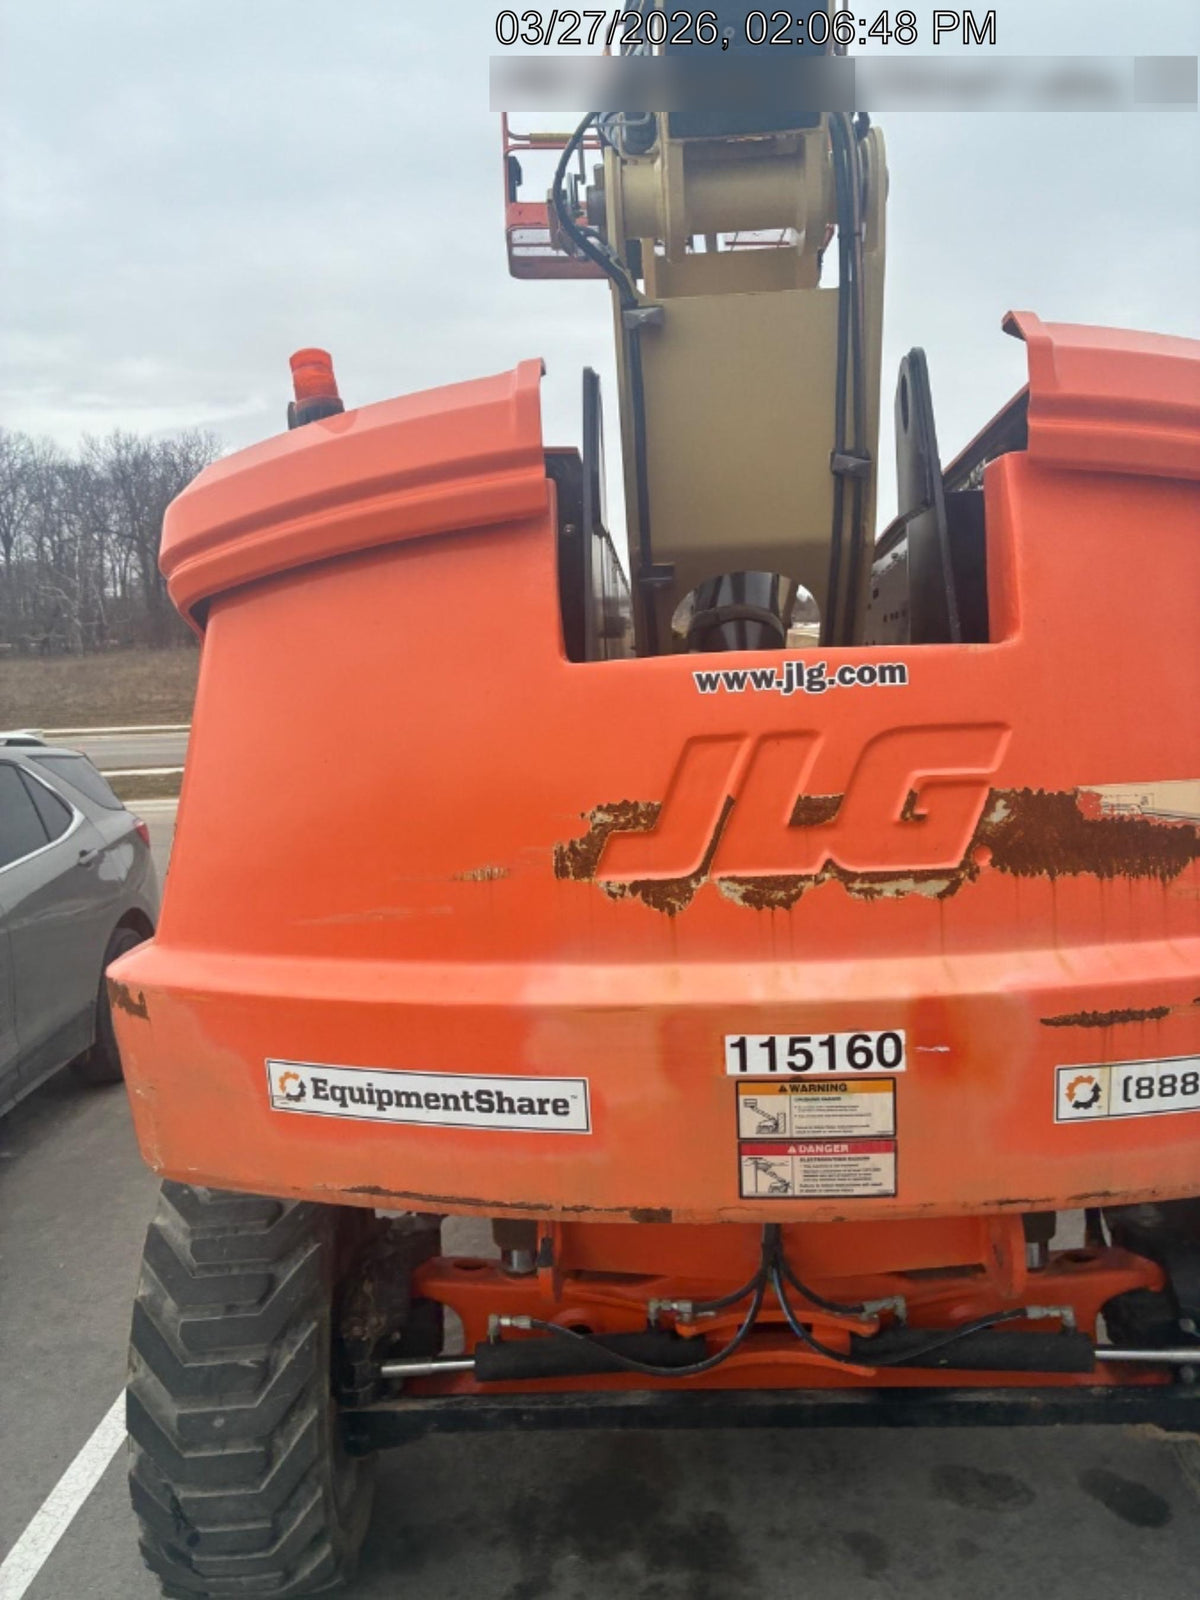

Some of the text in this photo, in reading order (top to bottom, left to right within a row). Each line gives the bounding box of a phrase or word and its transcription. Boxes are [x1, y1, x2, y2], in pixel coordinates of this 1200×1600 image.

[693, 660, 909, 695] www.jlg.com
[596, 721, 1012, 882] JLG
[729, 1031, 903, 1073] 115160
[311, 1078, 570, 1117] EquipmentShare
[789, 1083, 848, 1093] WARNING
[1123, 1071, 1200, 1103] (888
[798, 1144, 850, 1154] DANGER
